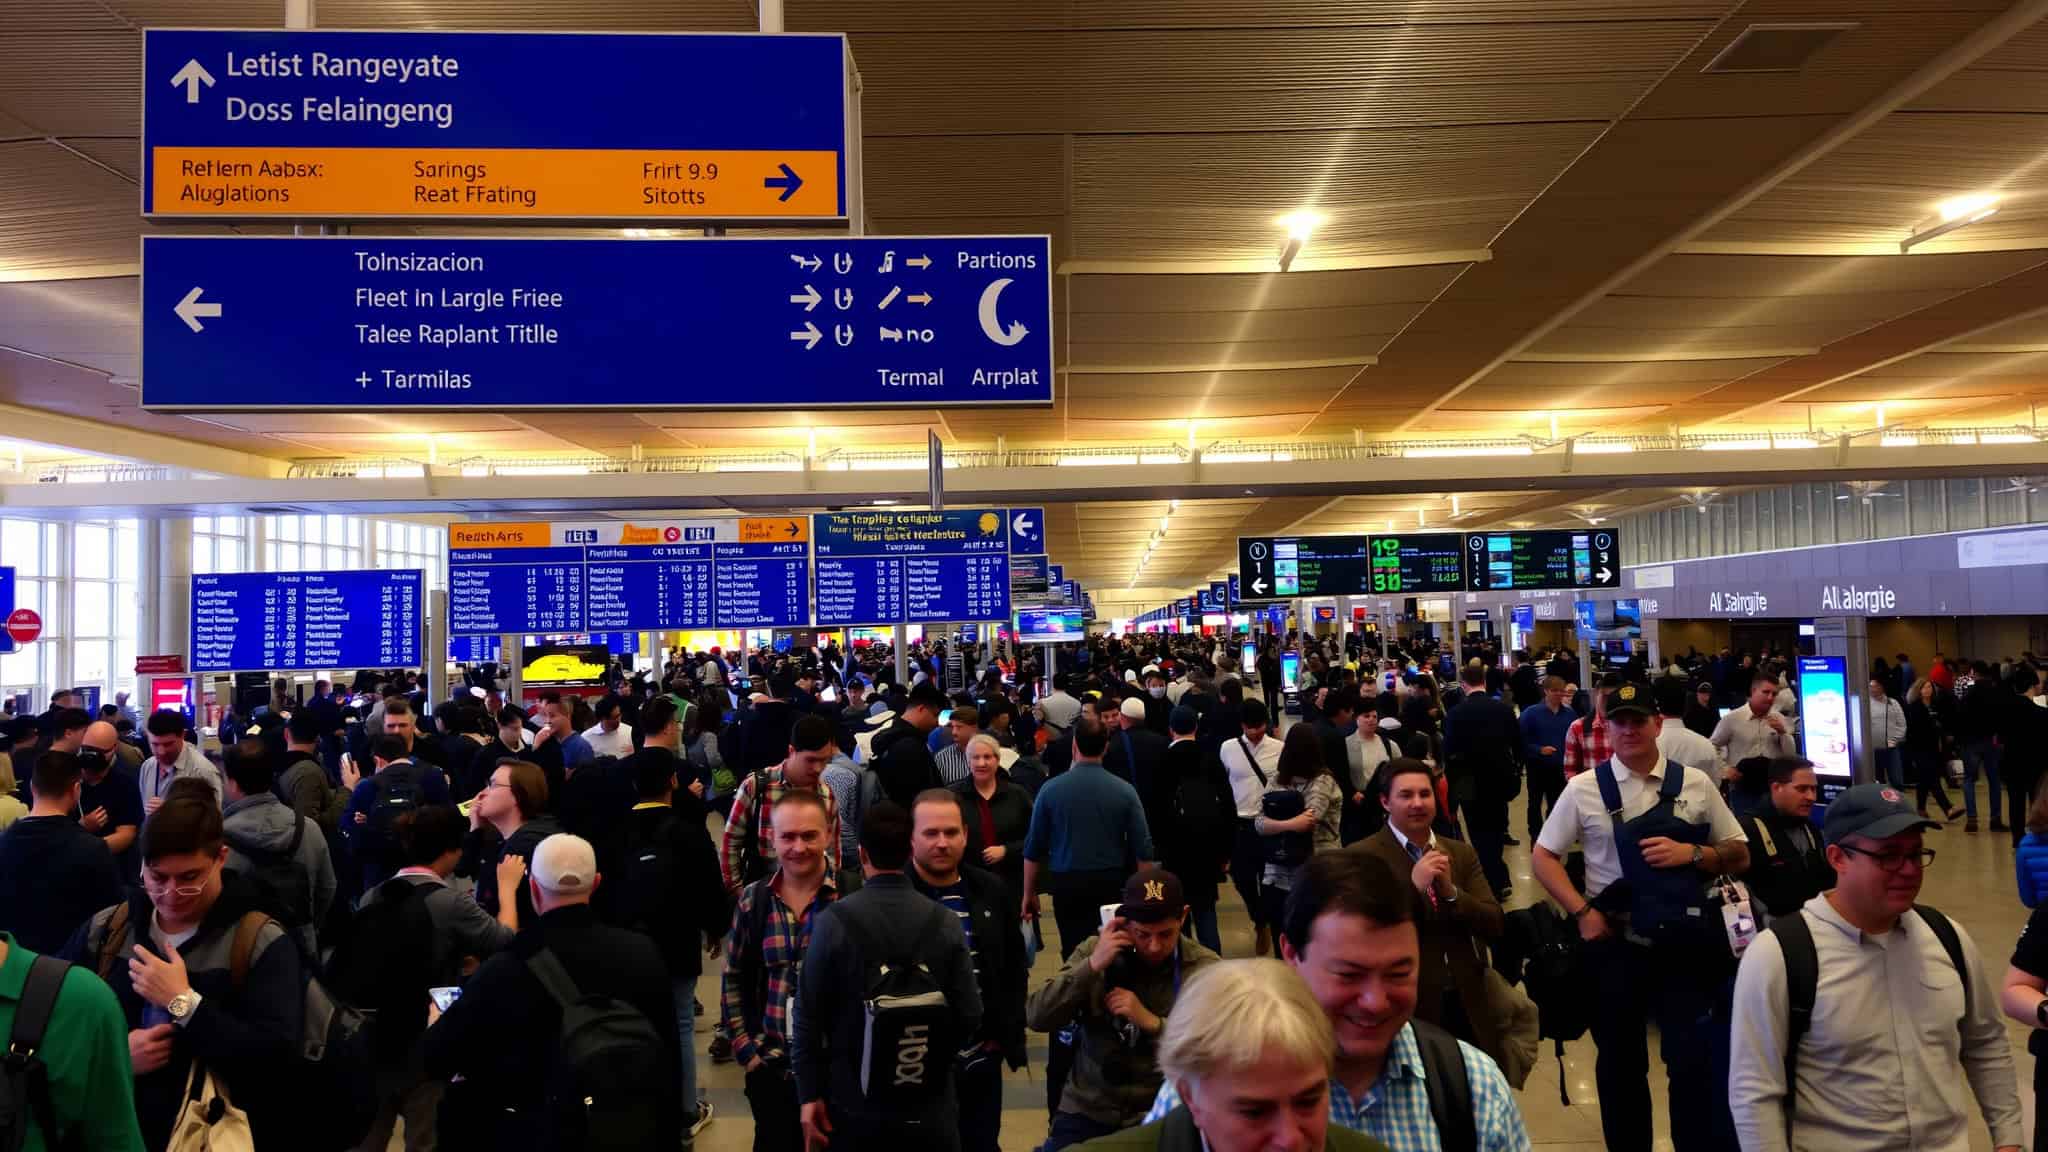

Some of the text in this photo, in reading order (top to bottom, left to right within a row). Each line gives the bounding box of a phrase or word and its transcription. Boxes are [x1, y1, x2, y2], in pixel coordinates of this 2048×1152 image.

[228, 52, 459, 82] Letist Rangeyate
[227, 97, 453, 128] Doss Felaingeng
[688, 162, 718, 181] 9.9
[414, 185, 460, 203] Reat
[957, 251, 1036, 269] Partions
[356, 288, 408, 307] Fleet
[441, 288, 505, 312] Largle
[513, 289, 563, 308] Friee
[355, 324, 412, 344] Talee
[419, 323, 499, 349] Raplant
[381, 369, 472, 389] Tarmilas
[878, 368, 944, 386] Termal
[972, 368, 1039, 389] Arrplat
